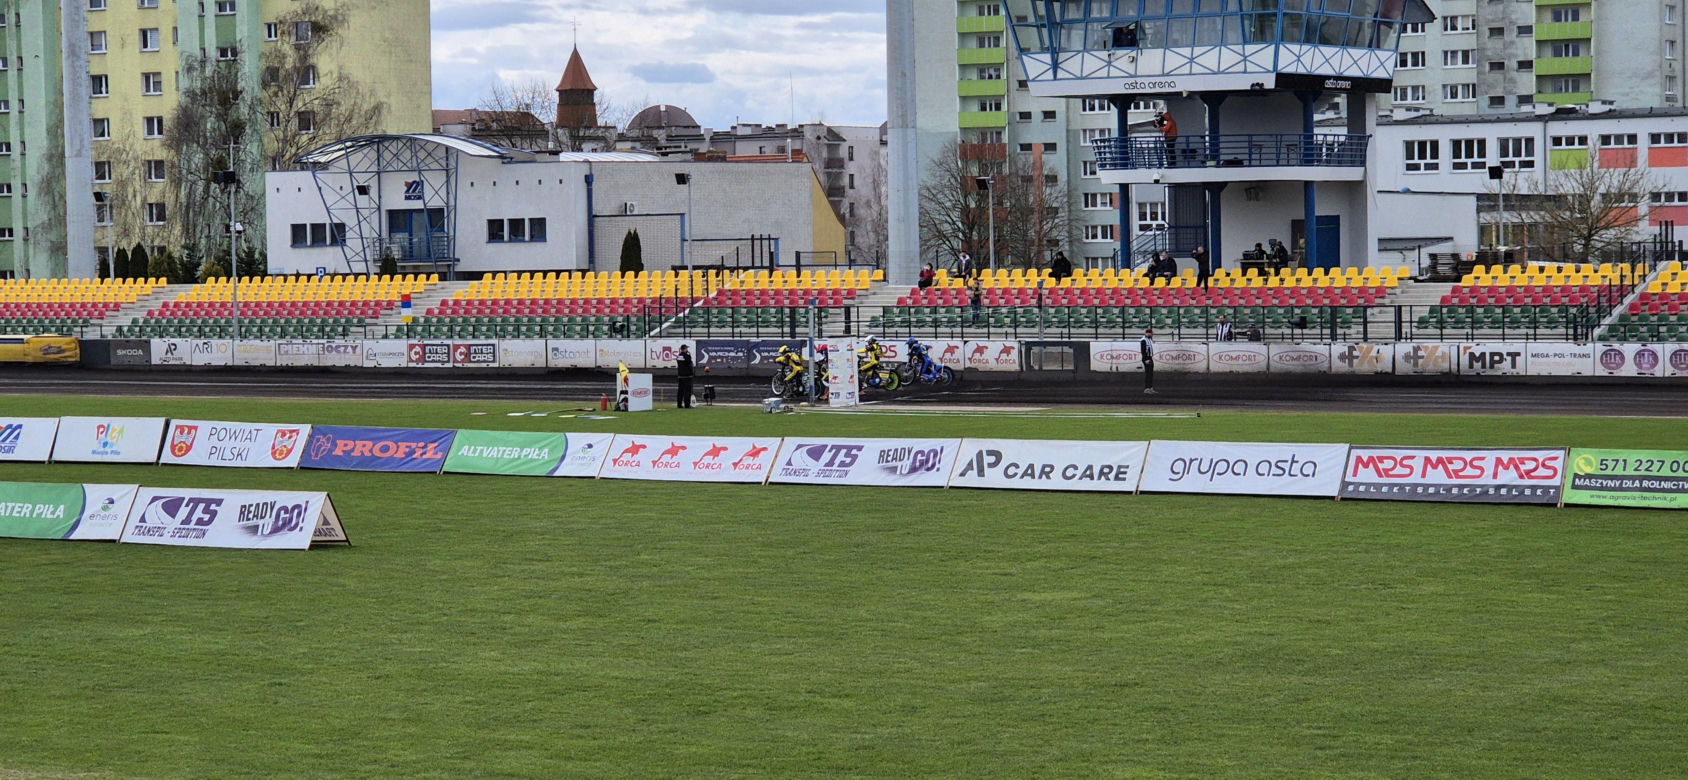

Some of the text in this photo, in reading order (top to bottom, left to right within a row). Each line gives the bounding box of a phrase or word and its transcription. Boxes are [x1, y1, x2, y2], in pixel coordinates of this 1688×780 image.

[1123, 80, 1177, 90] asta arena
[326, 345, 359, 354] OCZY
[426, 346, 448, 354] INTER
[471, 346, 493, 354] INTER
[1100, 353, 1138, 361] KOMFORT
[1159, 353, 1197, 361] KOMFORT
[1218, 354, 1257, 362] KOMFORT
[1279, 354, 1318, 363] KOMFORT
[1468, 351, 1522, 369] MPT
[208, 426, 263, 443] POWIAT
[208, 446, 249, 462] PILSKI
[458, 445, 549, 460] ALTVATER PIŁA
[823, 444, 865, 468] TS
[617, 460, 641, 468] ORCA
[658, 460, 681, 469] ORCA
[699, 462, 722, 470] ORCA
[878, 446, 944, 474] READY GO!
[959, 449, 1130, 482] AP CAR CARE
[1599, 458, 1628, 472] 571
[1633, 459, 1666, 473] 227
[739, 463, 763, 471] ORCA
[1169, 454, 1318, 482] grupa asta
[1352, 455, 1560, 480] MRS MRS MRS
[1574, 478, 1620, 488] MASZYNY
[1622, 479, 1640, 488] DLA
[33, 503, 65, 519] PIŁA
[89, 512, 119, 521] eneris
[179, 497, 224, 526] TS
[238, 500, 309, 532] READY GO!
[170, 526, 209, 540] SPEDITION
